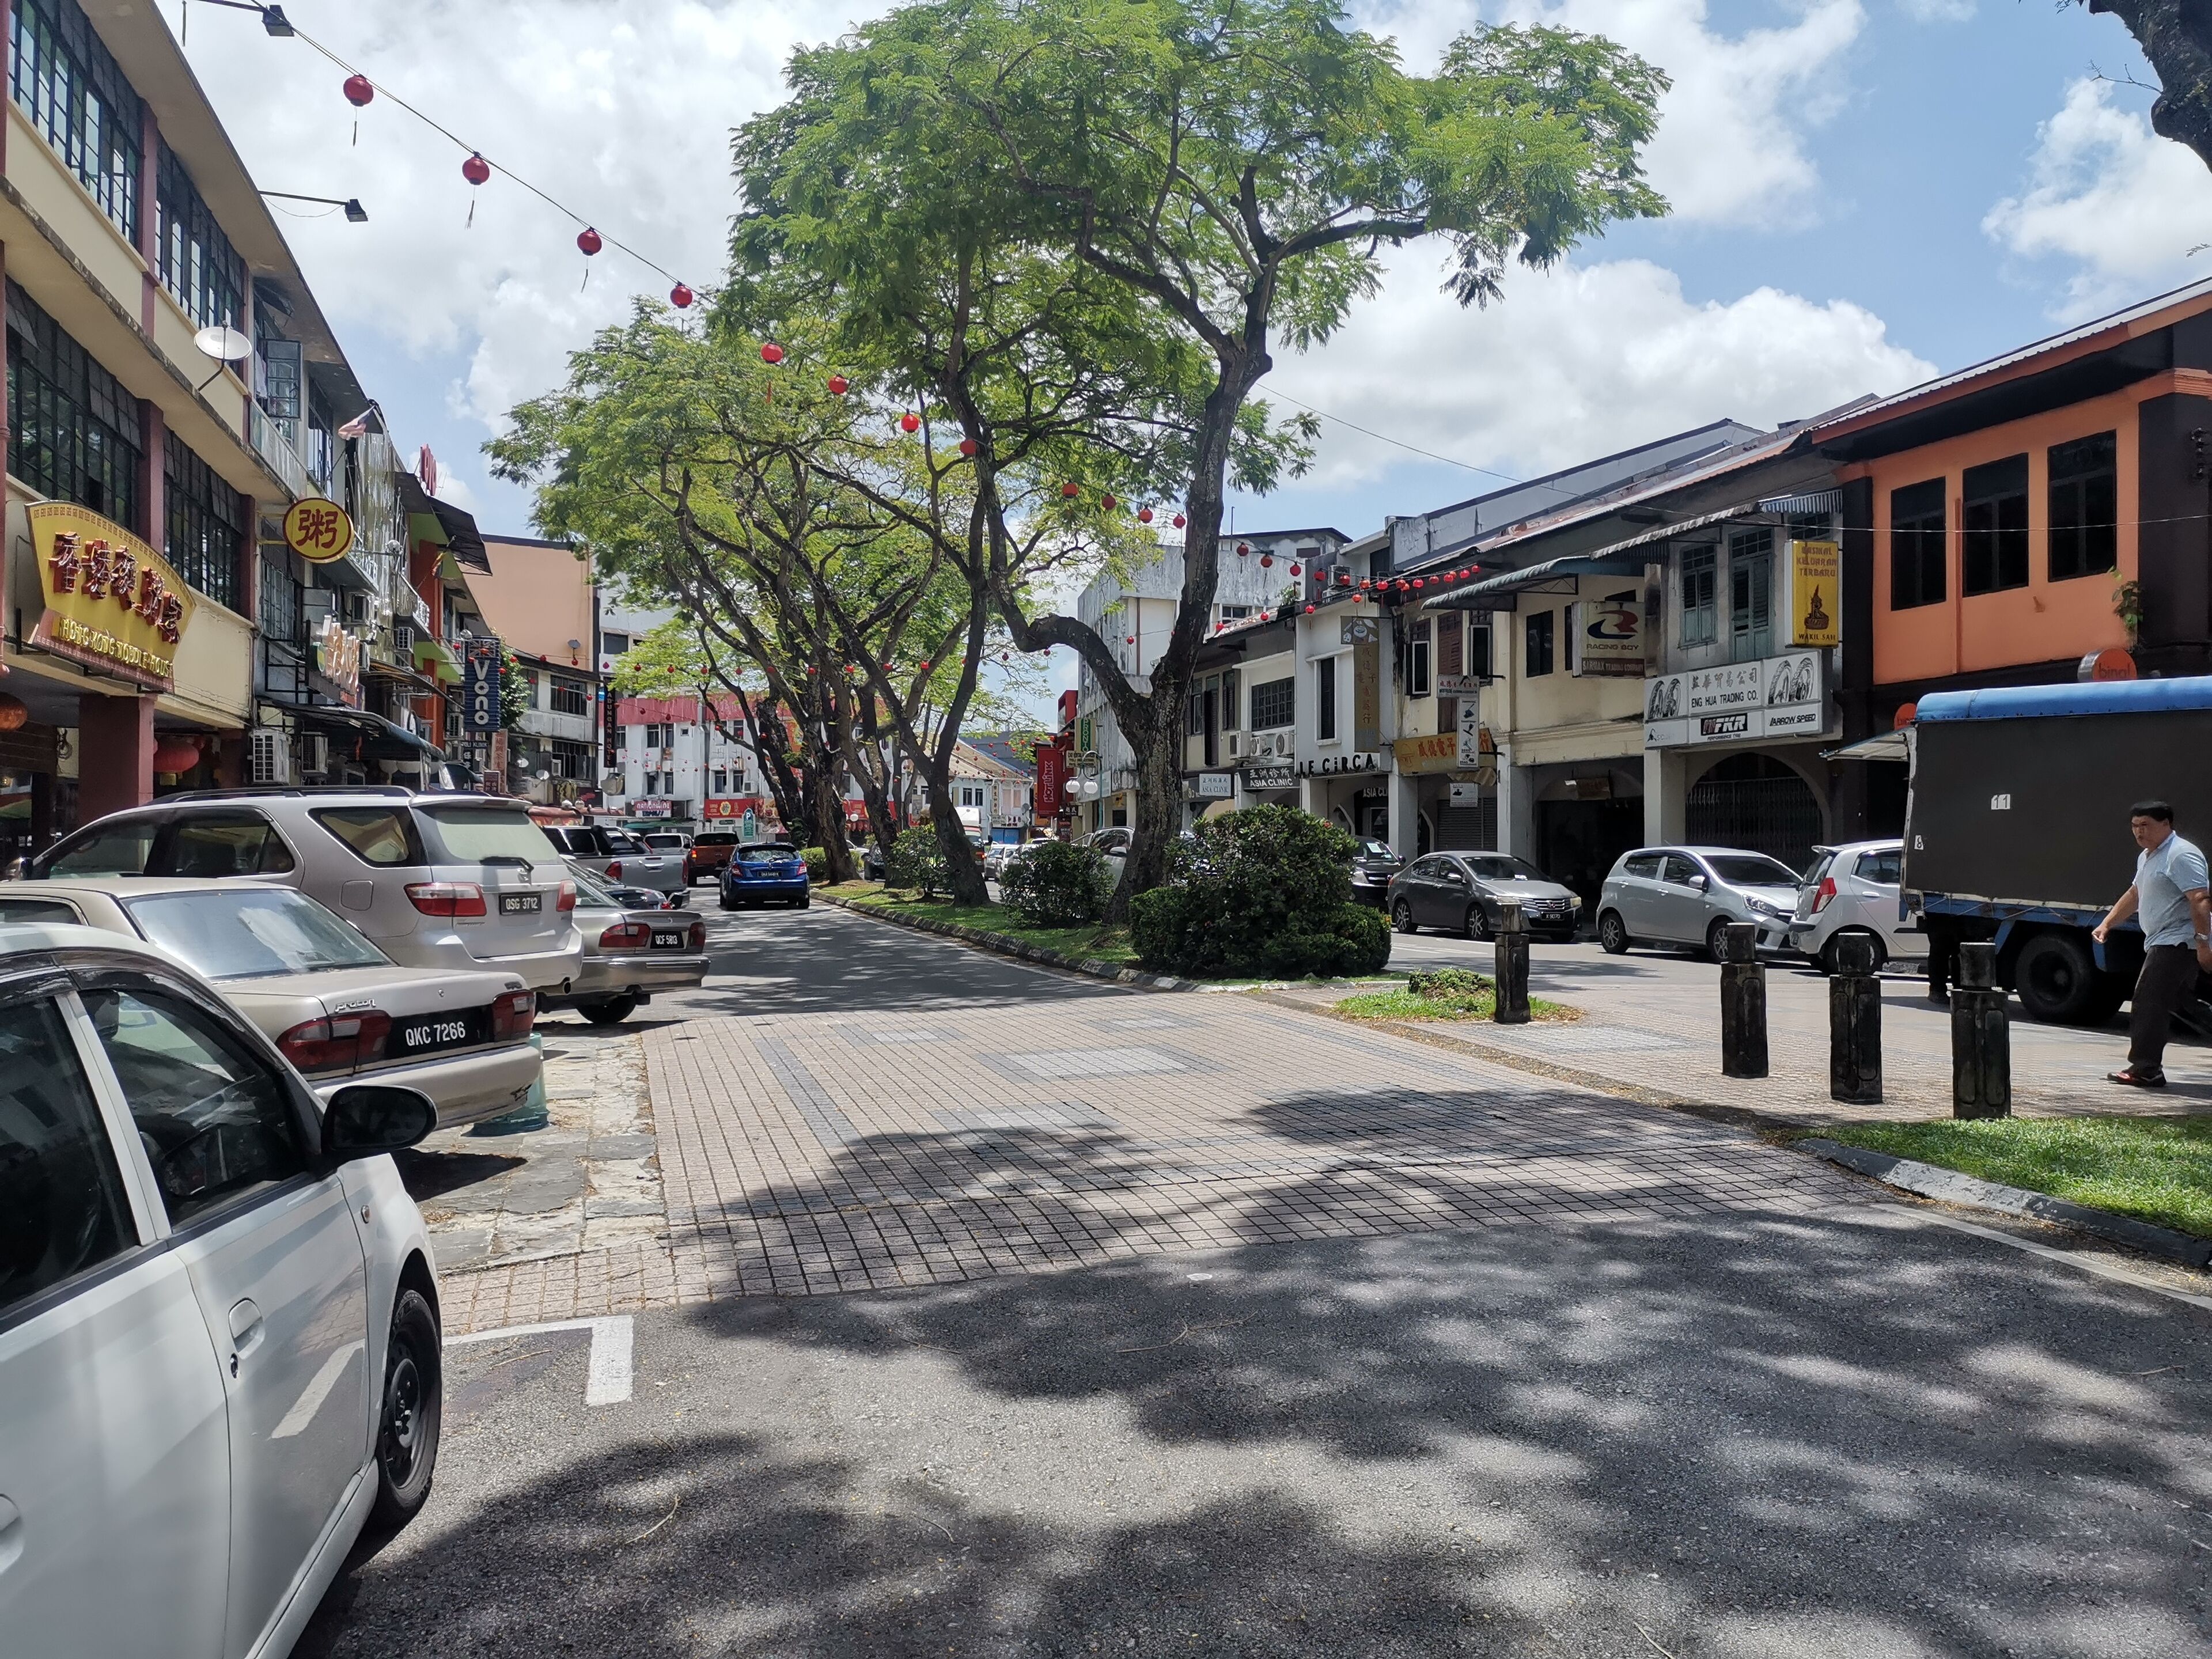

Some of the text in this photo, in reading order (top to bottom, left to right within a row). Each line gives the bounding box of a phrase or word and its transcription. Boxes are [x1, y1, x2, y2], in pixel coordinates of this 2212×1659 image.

[295, 508, 339, 550] 粥
[1799, 568, 1836, 577] TERBARU
[1691, 690, 1759, 708] ENG HUA TRADING CO.
[1797, 714, 1817, 723] SPEED
[1268, 778, 1293, 786] CLINIC
[1362, 787, 1388, 798] ASIA CLI
[746, 812, 751, 820] P
[522, 897, 538, 910] 3712
[405, 1021, 466, 1047] QKC 7266
